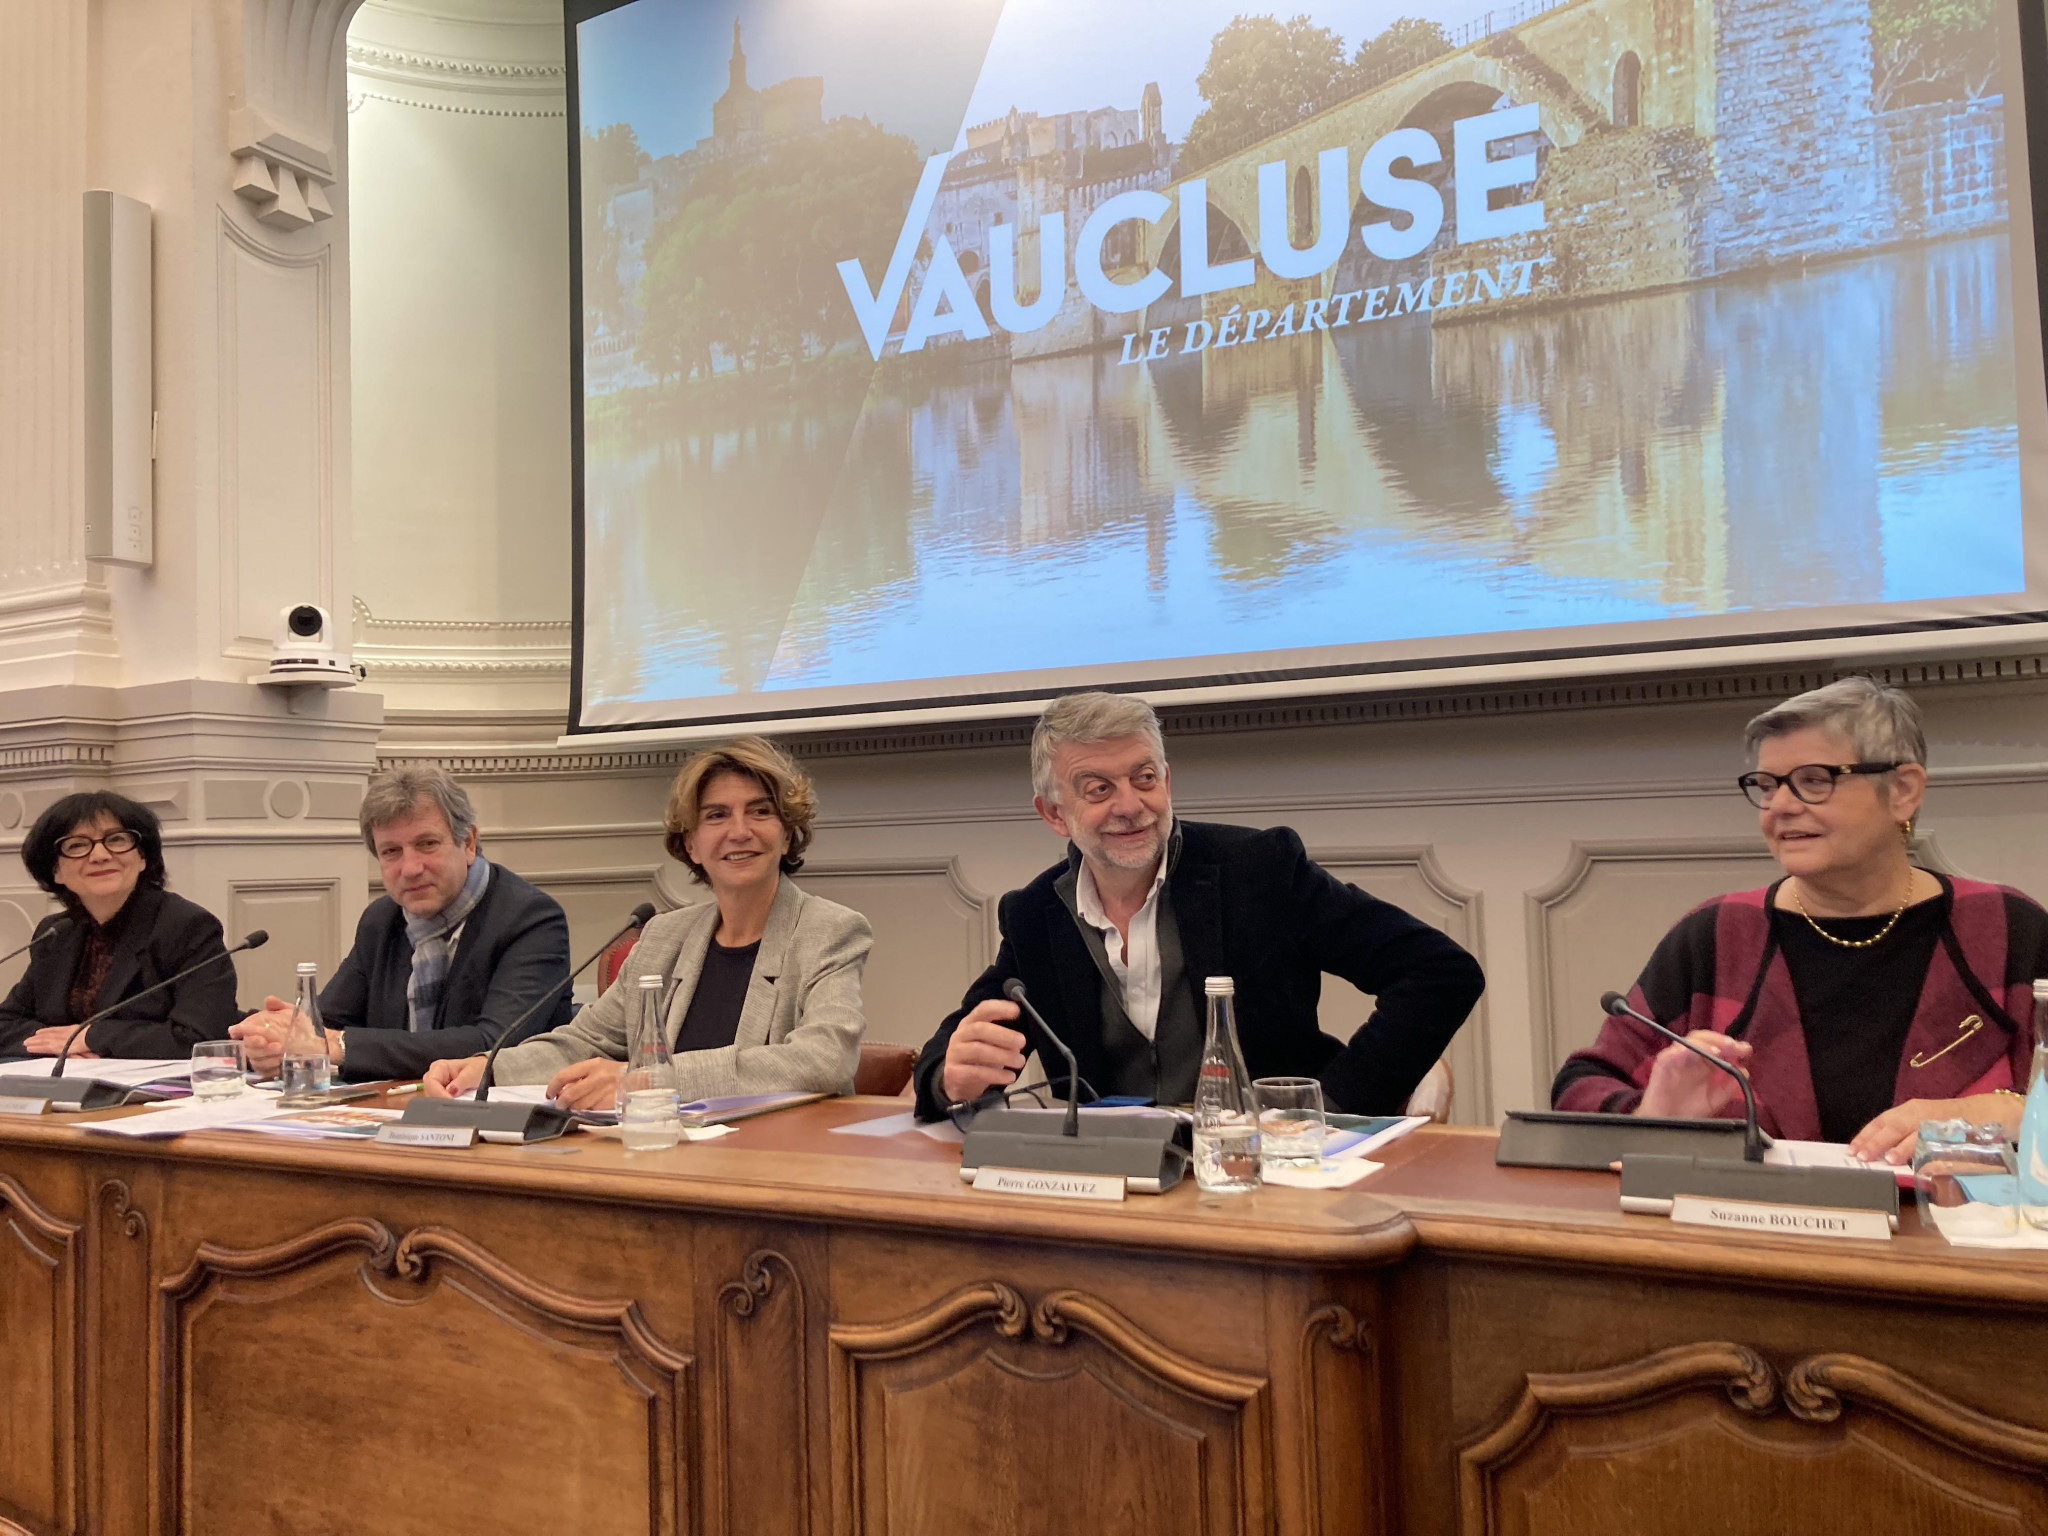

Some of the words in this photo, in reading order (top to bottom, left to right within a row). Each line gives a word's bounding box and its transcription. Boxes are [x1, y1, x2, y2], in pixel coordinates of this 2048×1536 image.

[836, 102, 1546, 361] VAUCLUSE
[1117, 327, 1171, 366] LE
[1178, 257, 1550, 354] DÉPARTEMENT
[997, 1176, 1025, 1189] Pierre
[1027, 1180, 1097, 1193] GONZALVEZ
[1709, 1207, 1765, 1225] Suzanne
[1770, 1214, 1849, 1231] BOUCHET
